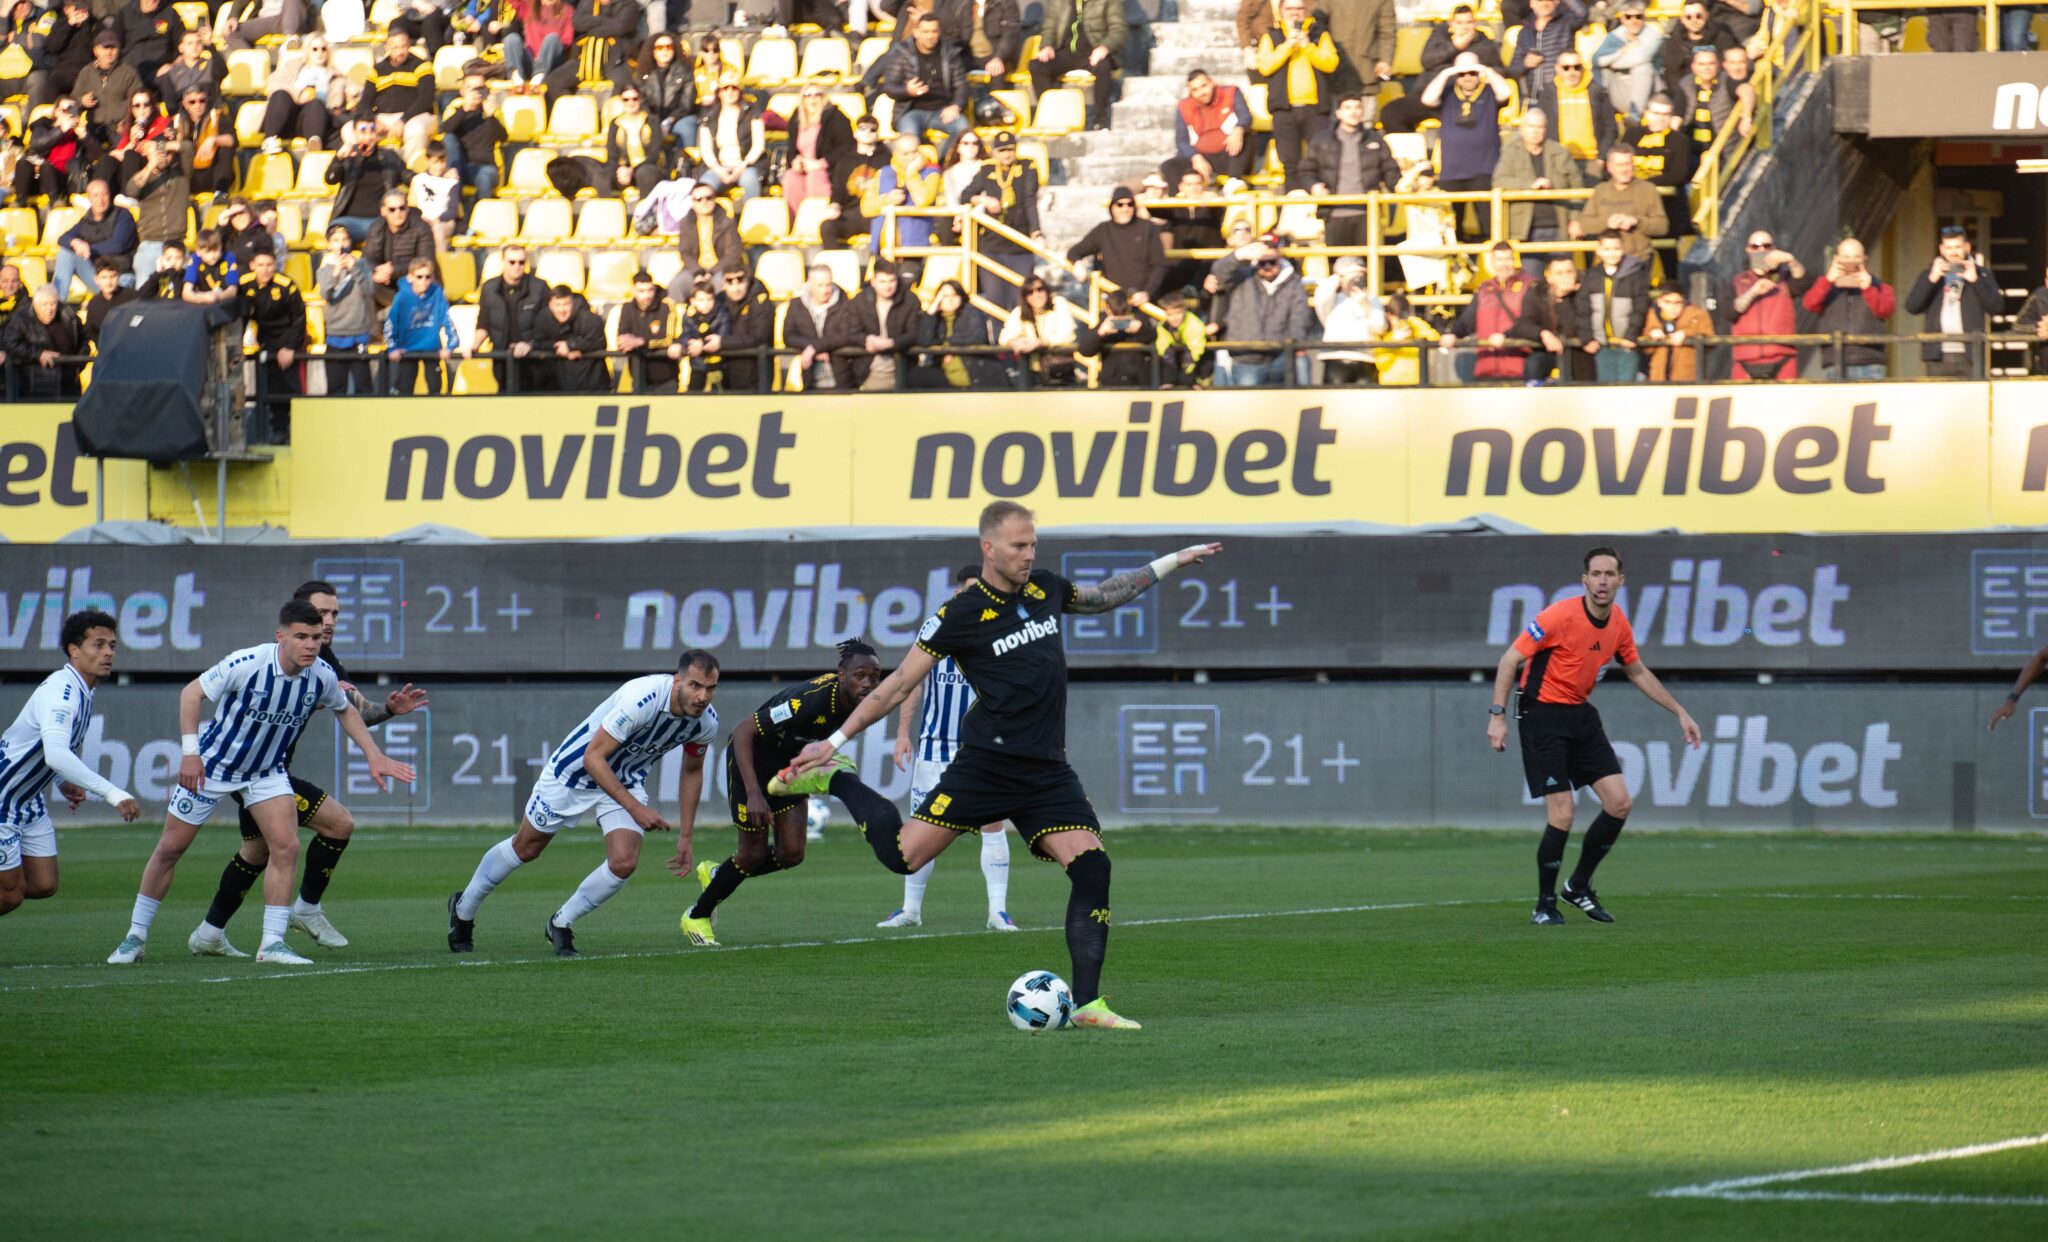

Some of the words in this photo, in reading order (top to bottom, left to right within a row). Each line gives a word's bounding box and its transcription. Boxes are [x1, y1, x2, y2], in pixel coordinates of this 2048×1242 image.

[1992, 82, 2048, 130] n
[384, 404, 797, 501] novibet
[910, 400, 1337, 499] novibet
[1445, 396, 1892, 497] novibet
[424, 584, 534, 633] 21+
[1179, 577, 1295, 628] 21+
[1487, 559, 1851, 647] nvibet
[991, 615, 1059, 657] novibet
[451, 731, 551, 785] 21+
[1242, 731, 1361, 785] 21+
[1521, 714, 1902, 808] ovibet
